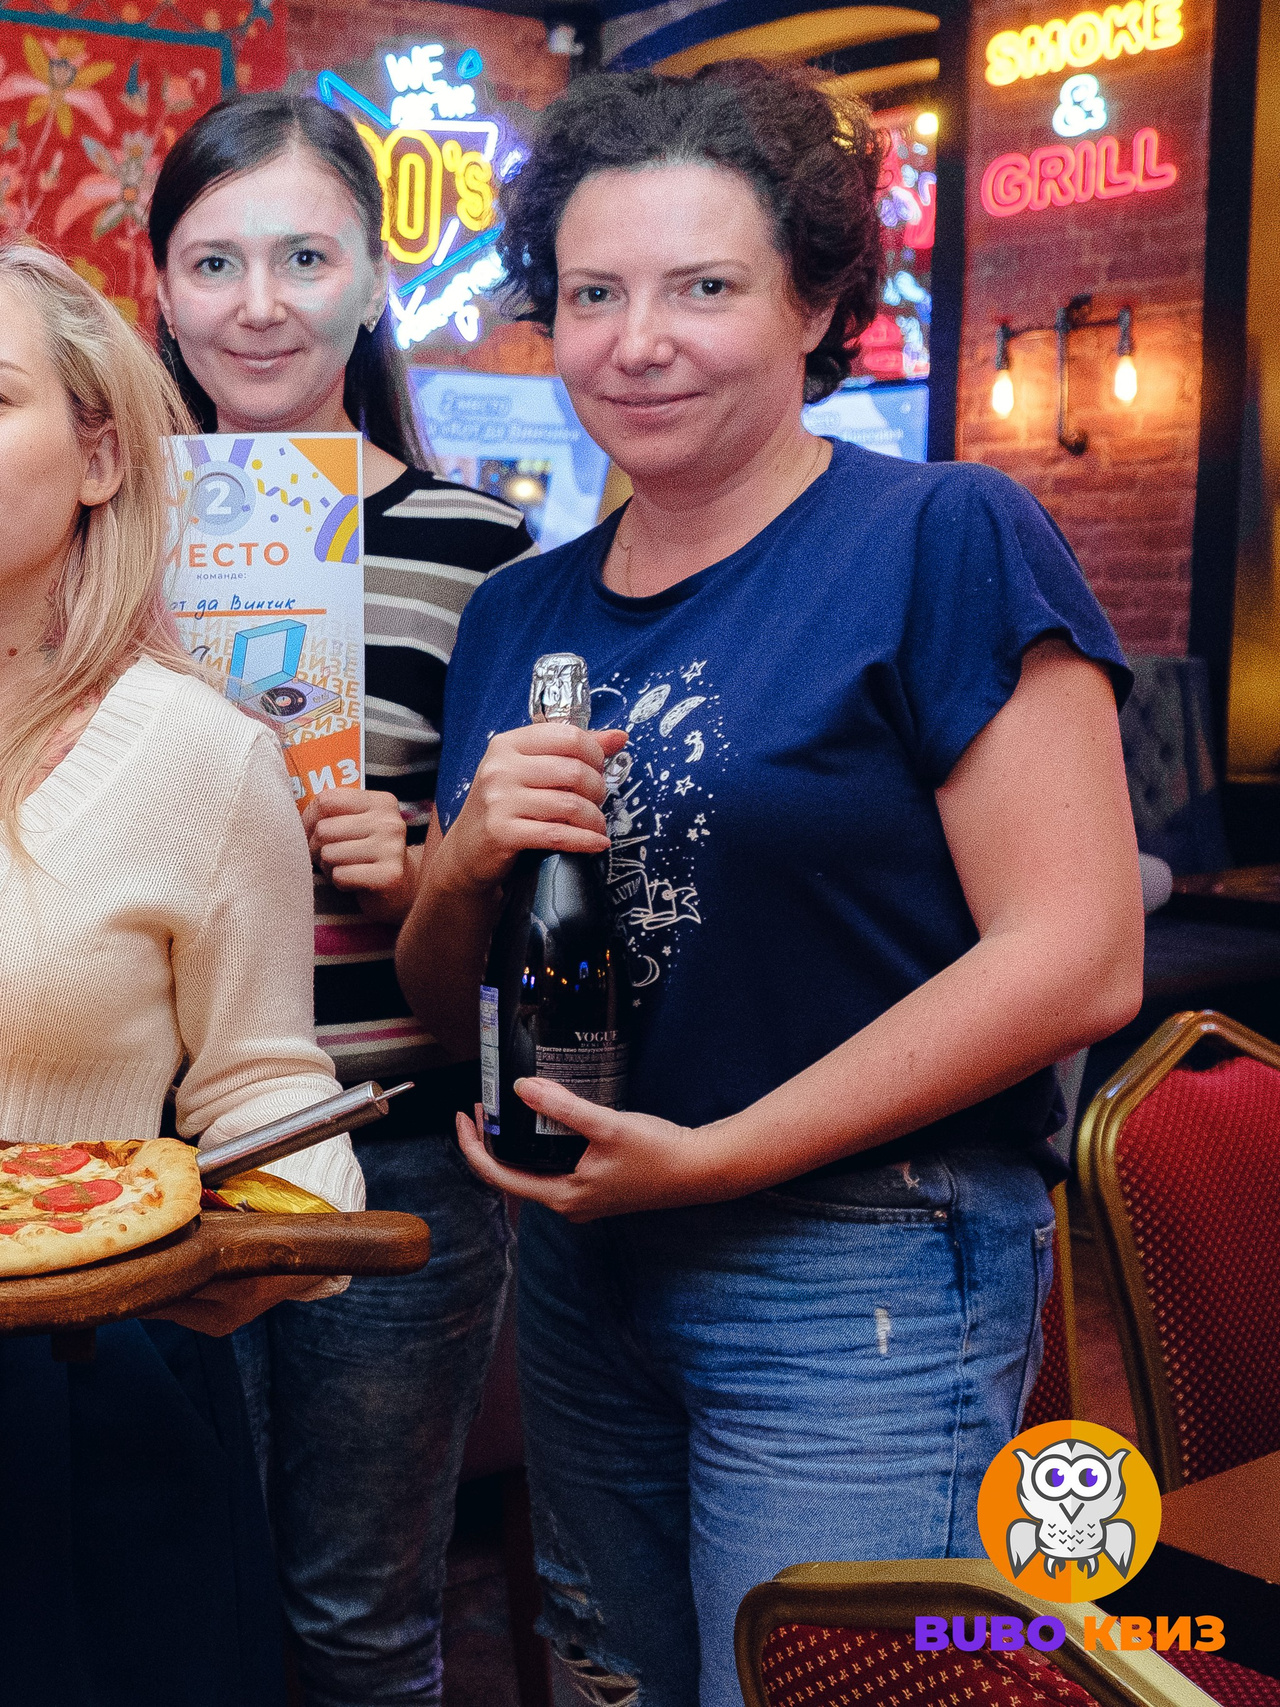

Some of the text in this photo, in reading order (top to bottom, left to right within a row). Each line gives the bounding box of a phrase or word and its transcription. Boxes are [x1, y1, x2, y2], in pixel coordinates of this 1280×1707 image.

[985, 0, 1184, 86] SMOKE
[385, 43, 444, 93] WE
[1052, 74, 1107, 137] &
[981, 127, 1177, 217] GRILL
[205, 481, 232, 516] 2
[196, 572, 248, 580] команде:
[170, 600, 187, 612] от
[194, 599, 219, 620] да
[575, 1030, 618, 1042] VOGUE
